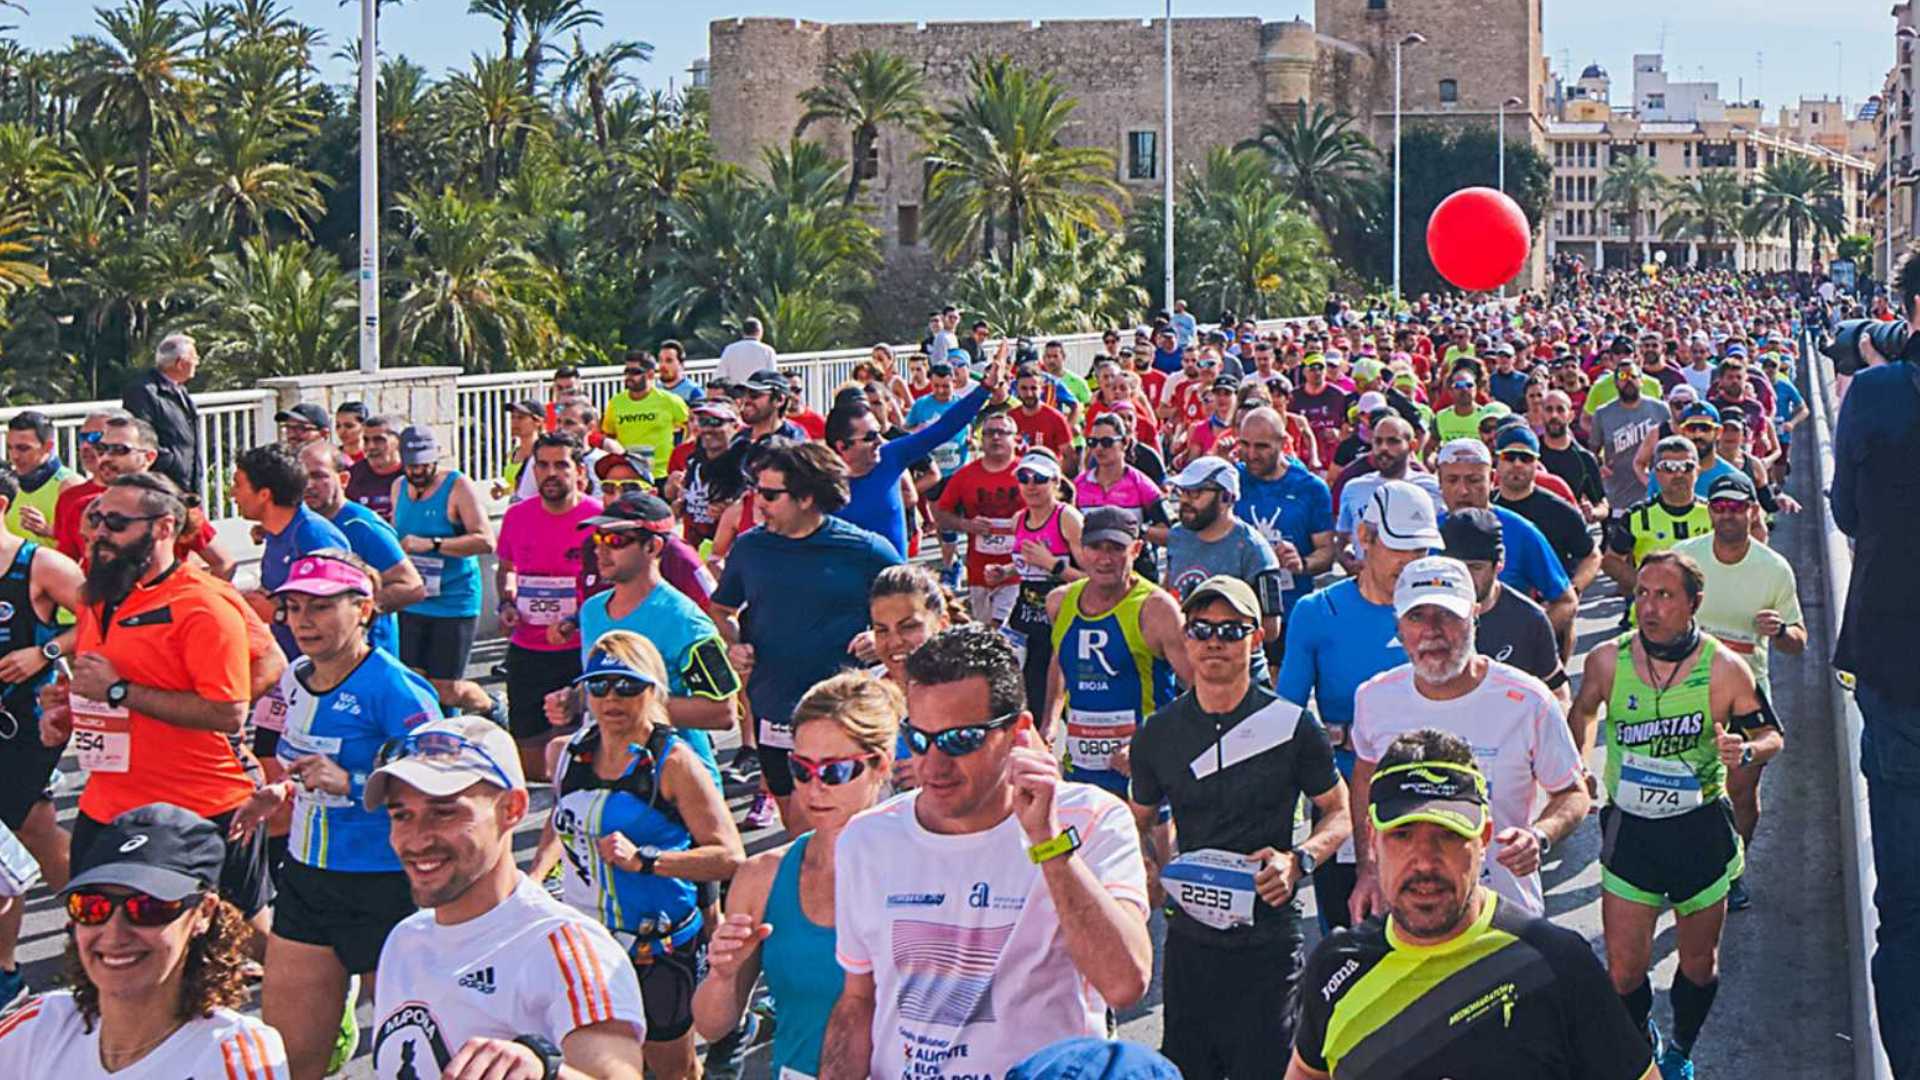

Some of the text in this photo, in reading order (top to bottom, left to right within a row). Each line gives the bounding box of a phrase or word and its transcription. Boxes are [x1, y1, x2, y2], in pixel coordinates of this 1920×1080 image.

[529, 599, 561, 612] 2015
[1078, 629, 1120, 677] R
[1077, 681, 1109, 691] RIOJA
[1615, 713, 1703, 744] FONDISTAS
[1640, 787, 1680, 806] 1774
[1181, 884, 1232, 911] 2233
